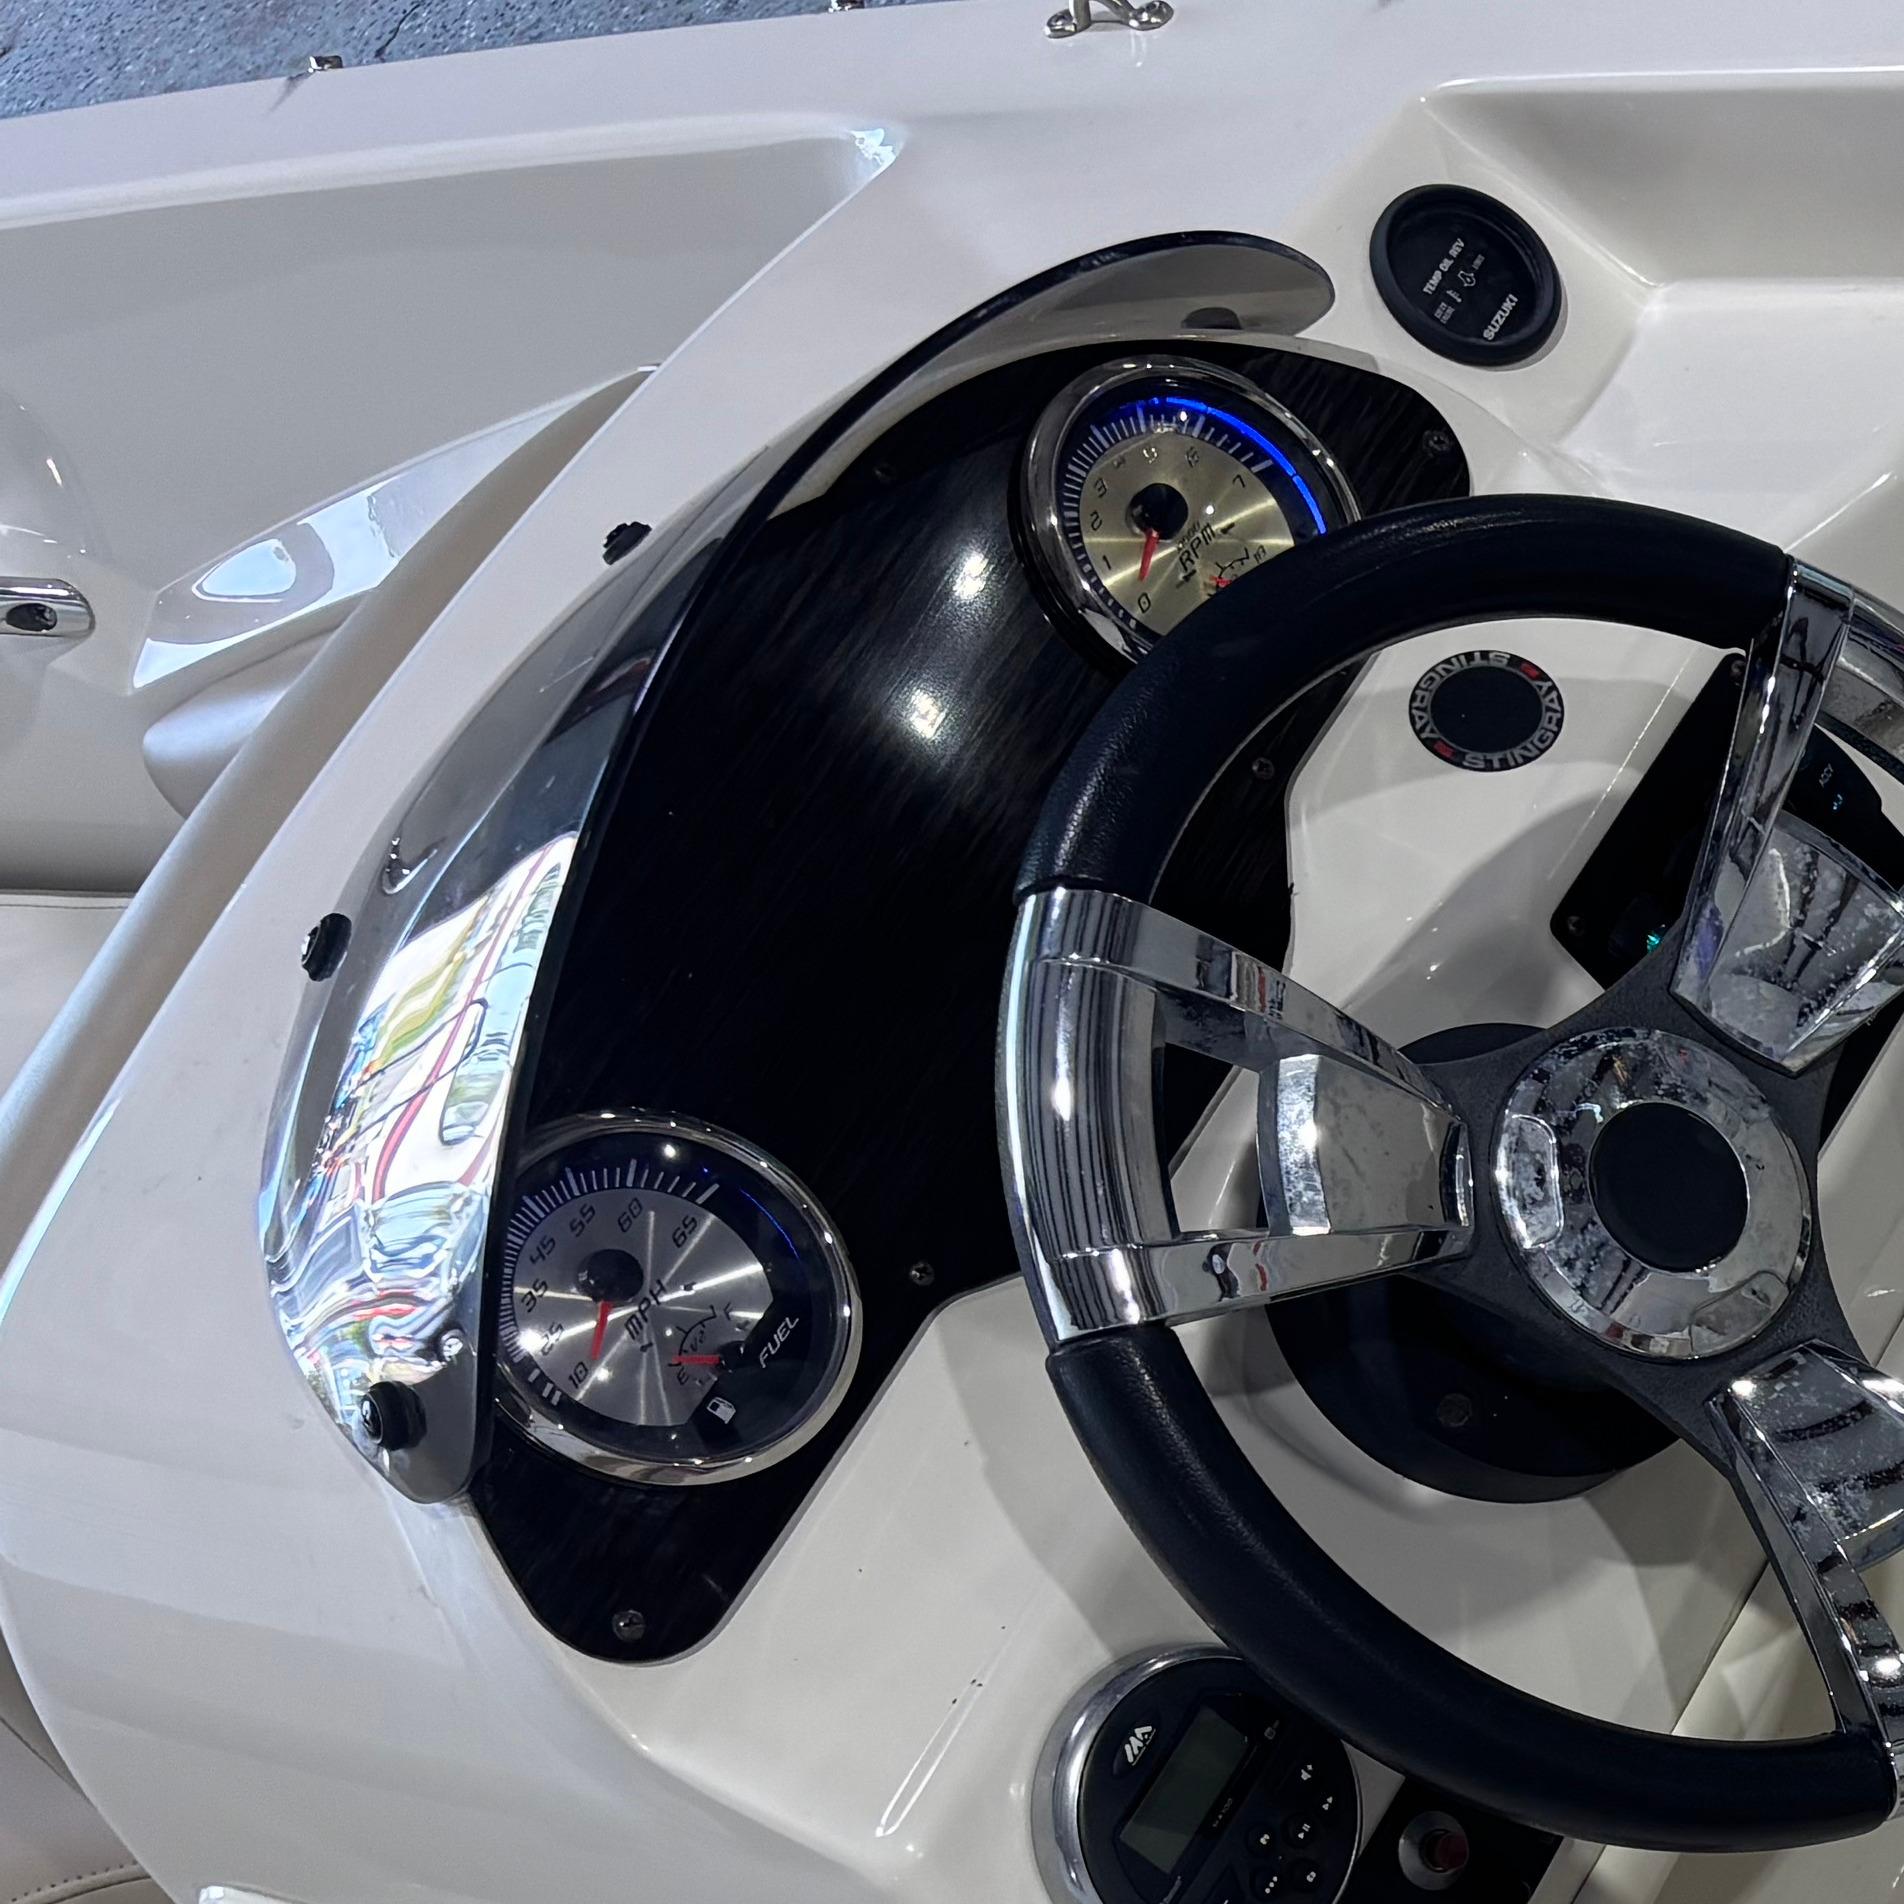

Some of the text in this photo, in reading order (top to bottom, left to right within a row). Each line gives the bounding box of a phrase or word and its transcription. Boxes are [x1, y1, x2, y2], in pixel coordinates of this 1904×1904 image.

[1483, 293, 1519, 341] SUZUKI
[1178, 524, 1216, 573] RPM
[1411, 651, 1511, 740] STINGRAY
[1462, 680, 1562, 769] STINGRAY
[568, 1203, 596, 1238] 55
[617, 1197, 644, 1233] 60
[672, 1215, 699, 1248] 65
[529, 1235, 557, 1267] 45
[520, 1278, 548, 1313] 35
[624, 1279, 668, 1342] MPH
[758, 1315, 799, 1369] FUEL
[567, 1361, 590, 1389] 10
